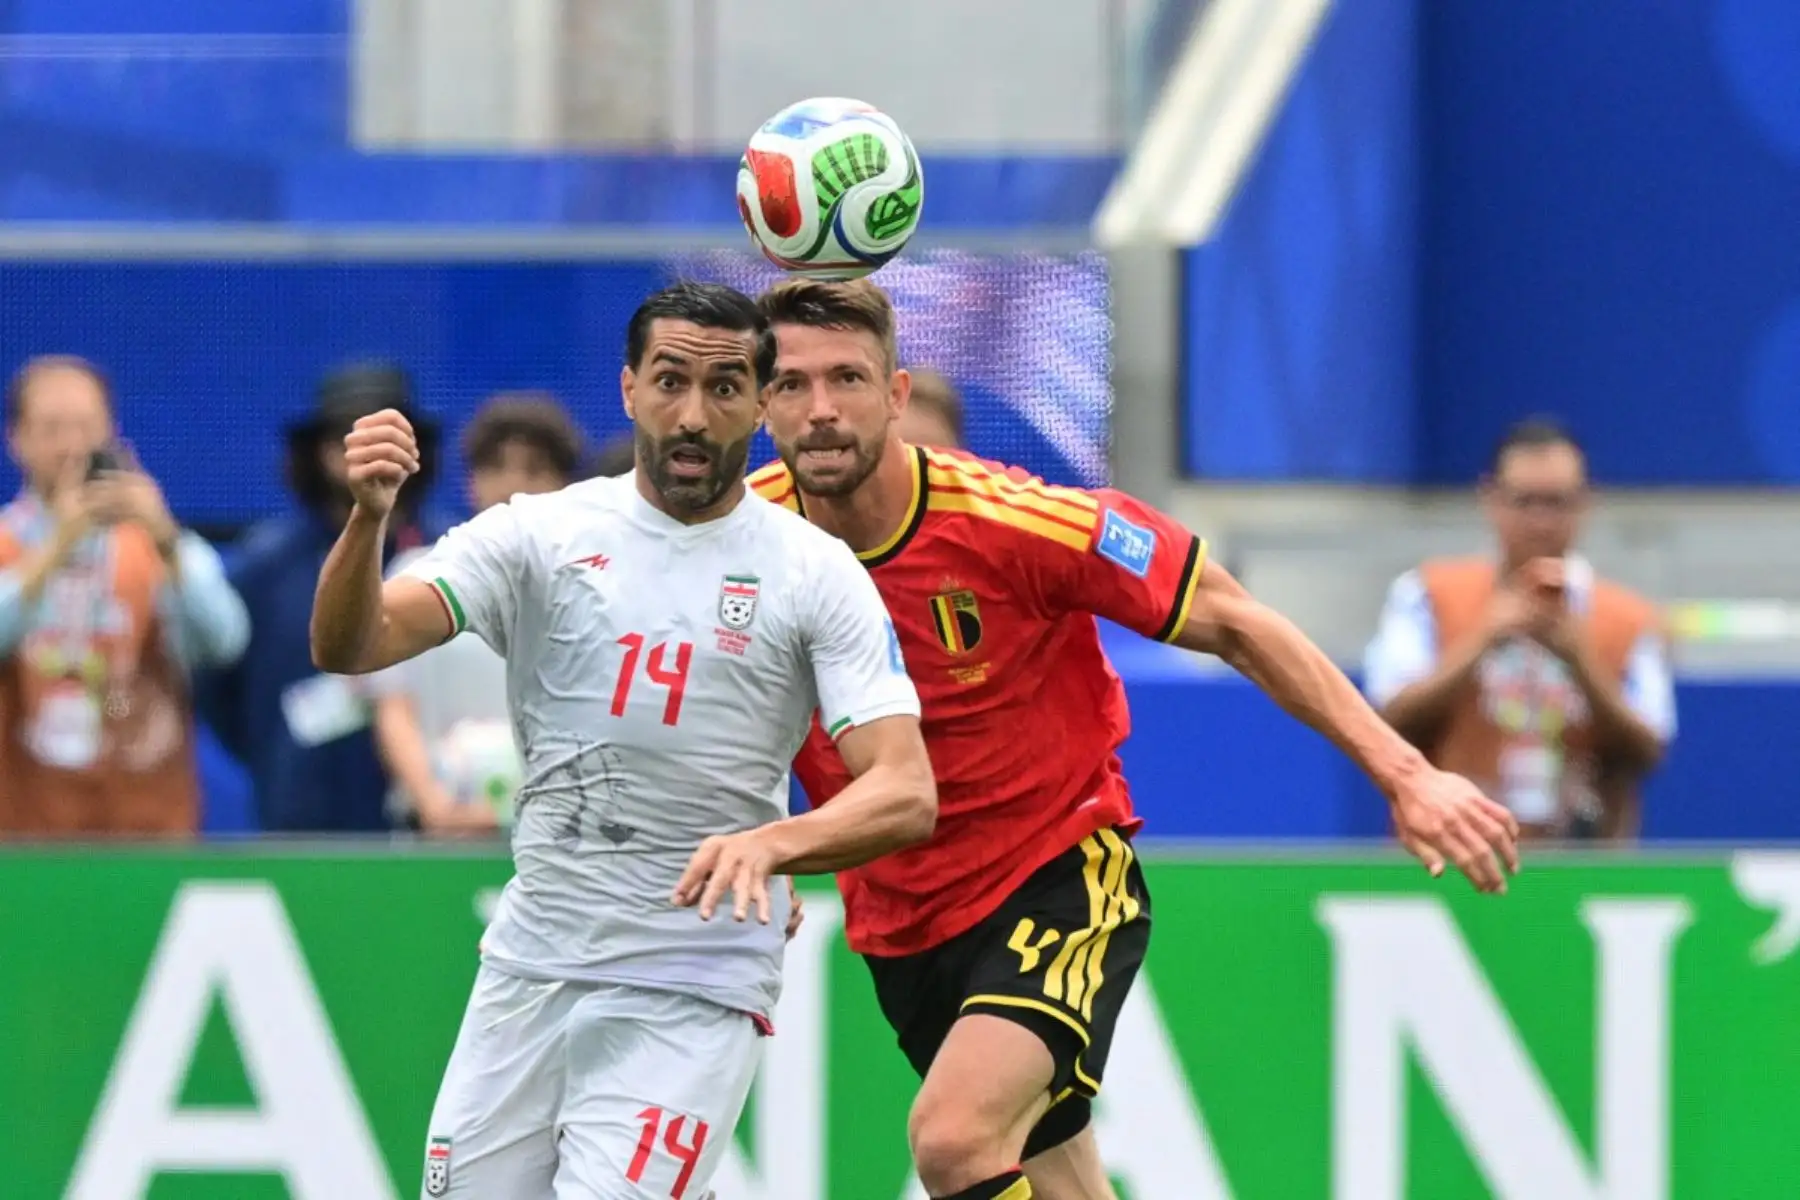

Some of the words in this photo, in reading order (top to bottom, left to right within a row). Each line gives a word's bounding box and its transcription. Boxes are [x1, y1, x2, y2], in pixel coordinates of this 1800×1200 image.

[610, 632, 694, 727] 14
[1007, 917, 1061, 973] 4
[625, 1106, 709, 1200] 14
